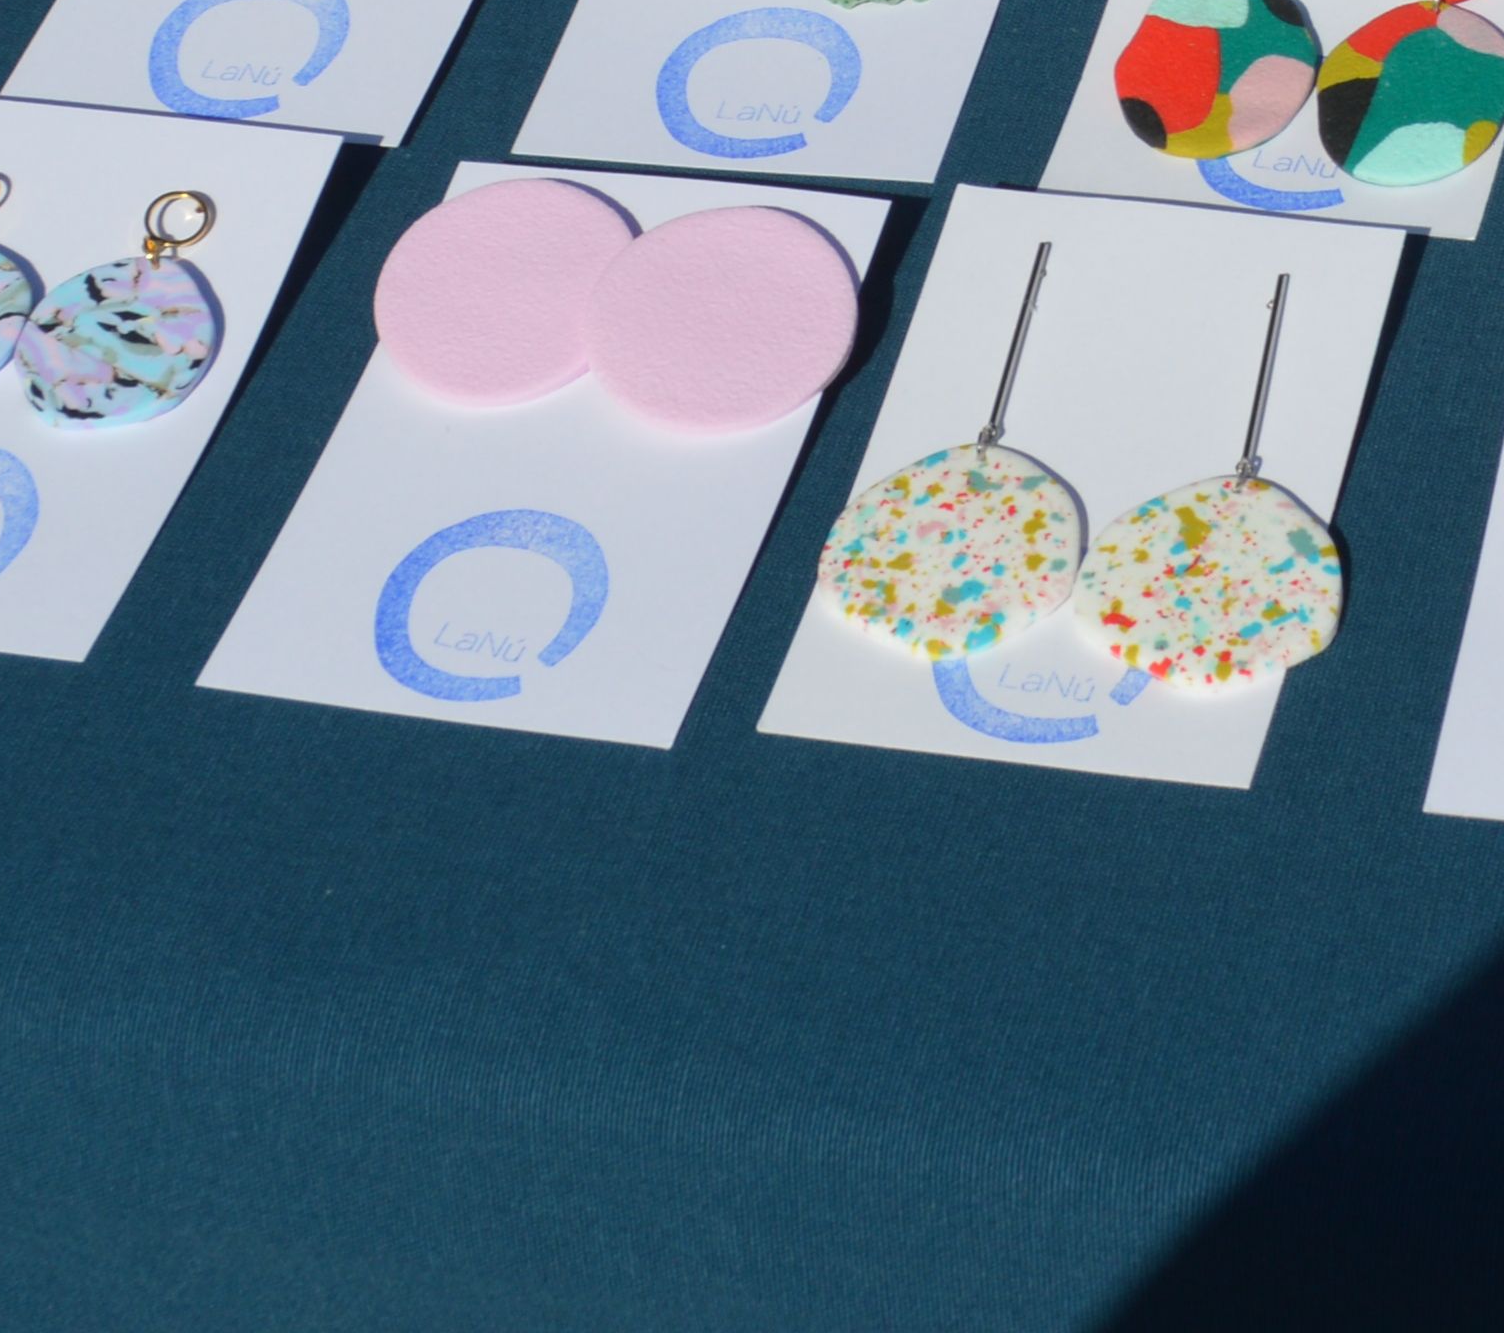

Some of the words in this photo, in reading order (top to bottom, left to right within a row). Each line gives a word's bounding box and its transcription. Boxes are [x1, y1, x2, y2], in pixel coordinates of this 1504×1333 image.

[202, 59, 281, 85] LaNú
[717, 100, 801, 124] LaNú
[434, 623, 525, 663] LaNú
[998, 664, 1095, 703] LaNú
